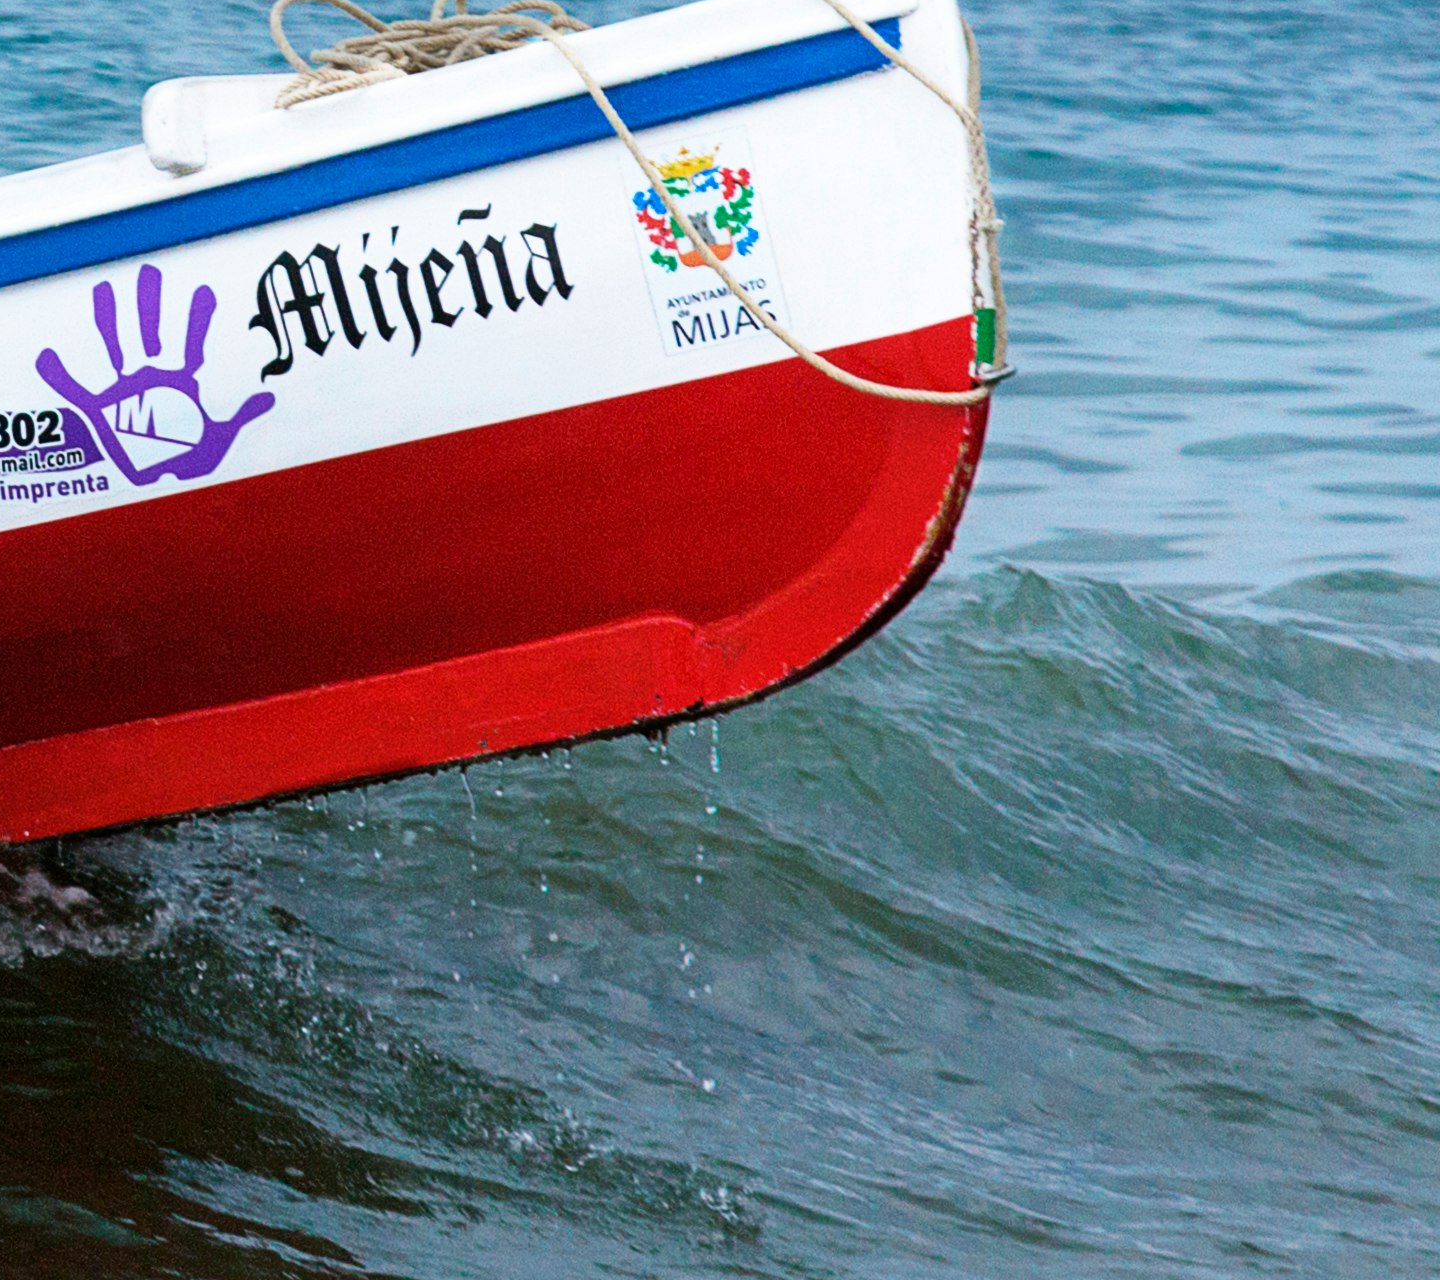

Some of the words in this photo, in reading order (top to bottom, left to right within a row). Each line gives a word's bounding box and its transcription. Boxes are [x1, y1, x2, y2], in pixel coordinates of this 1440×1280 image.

[249, 203, 575, 383] Mijeña
[666, 277, 767, 310] AYUNTAMNTO
[0, 473, 110, 503] imprenta
